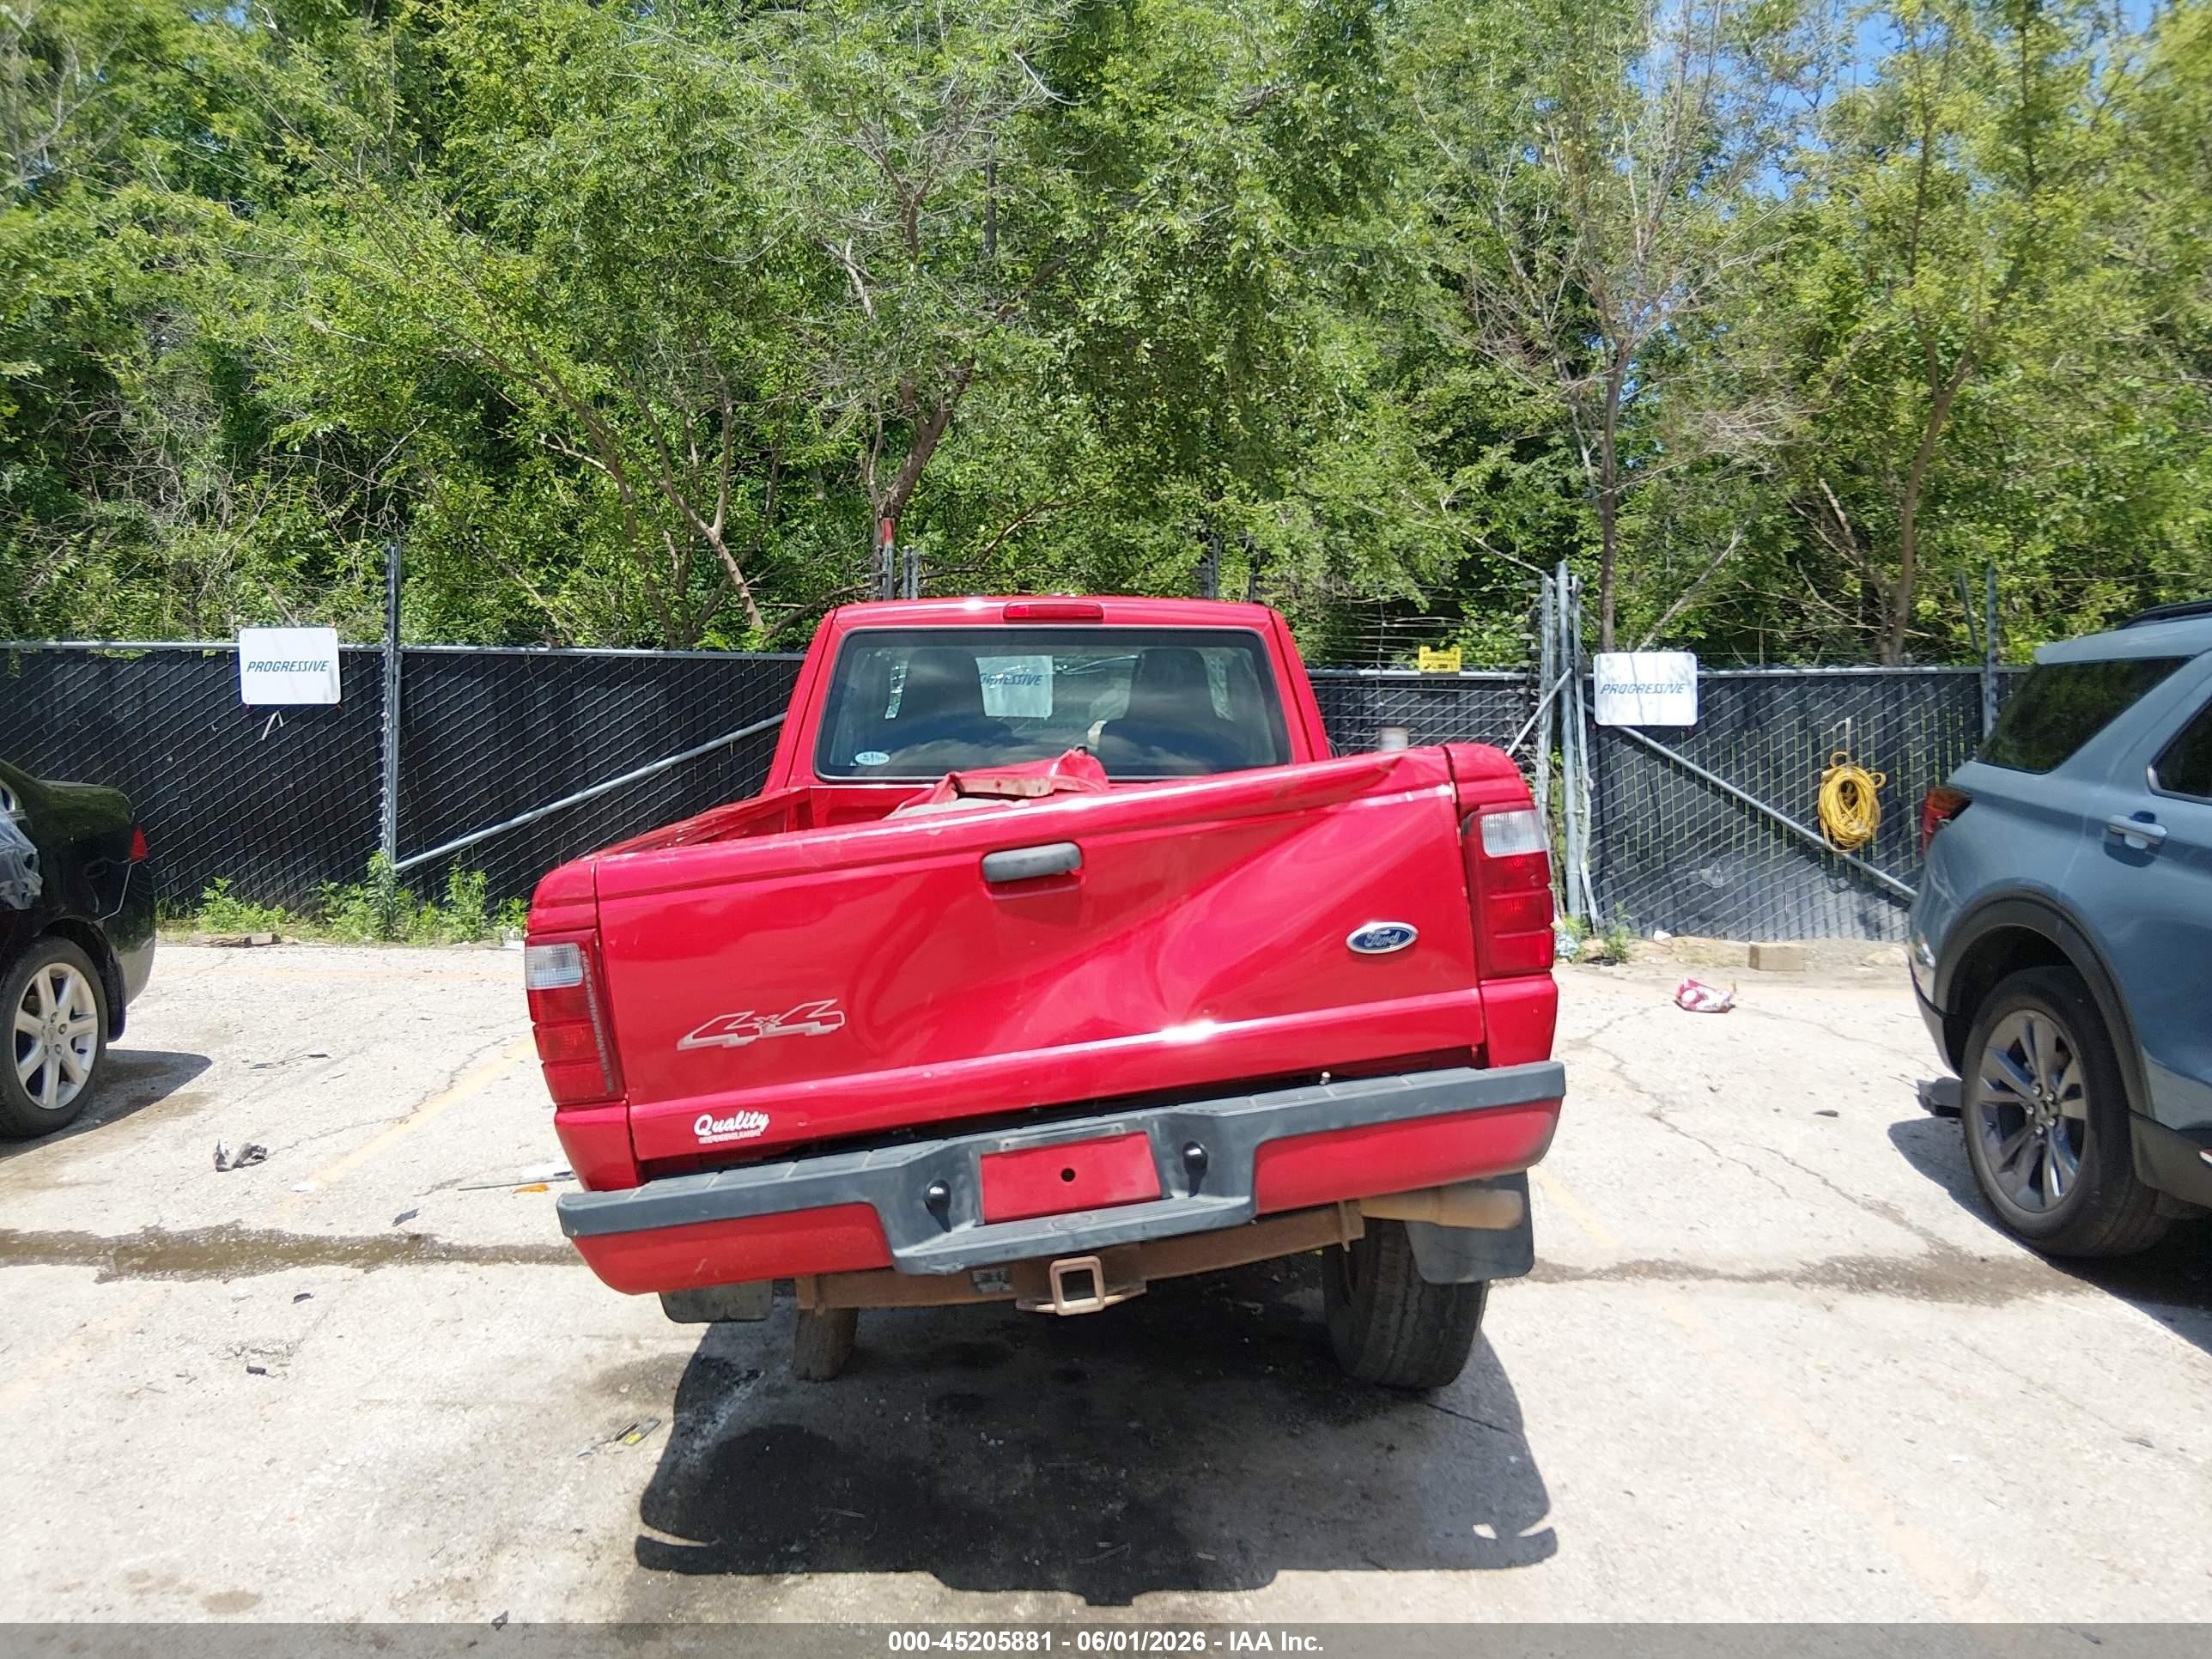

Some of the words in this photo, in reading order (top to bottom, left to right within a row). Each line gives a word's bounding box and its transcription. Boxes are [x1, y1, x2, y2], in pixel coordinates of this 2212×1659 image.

[246, 659, 330, 672] PROGRESSIVE
[1599, 683, 1686, 695] PROGRESSIVE
[694, 1109, 770, 1137] Quality
